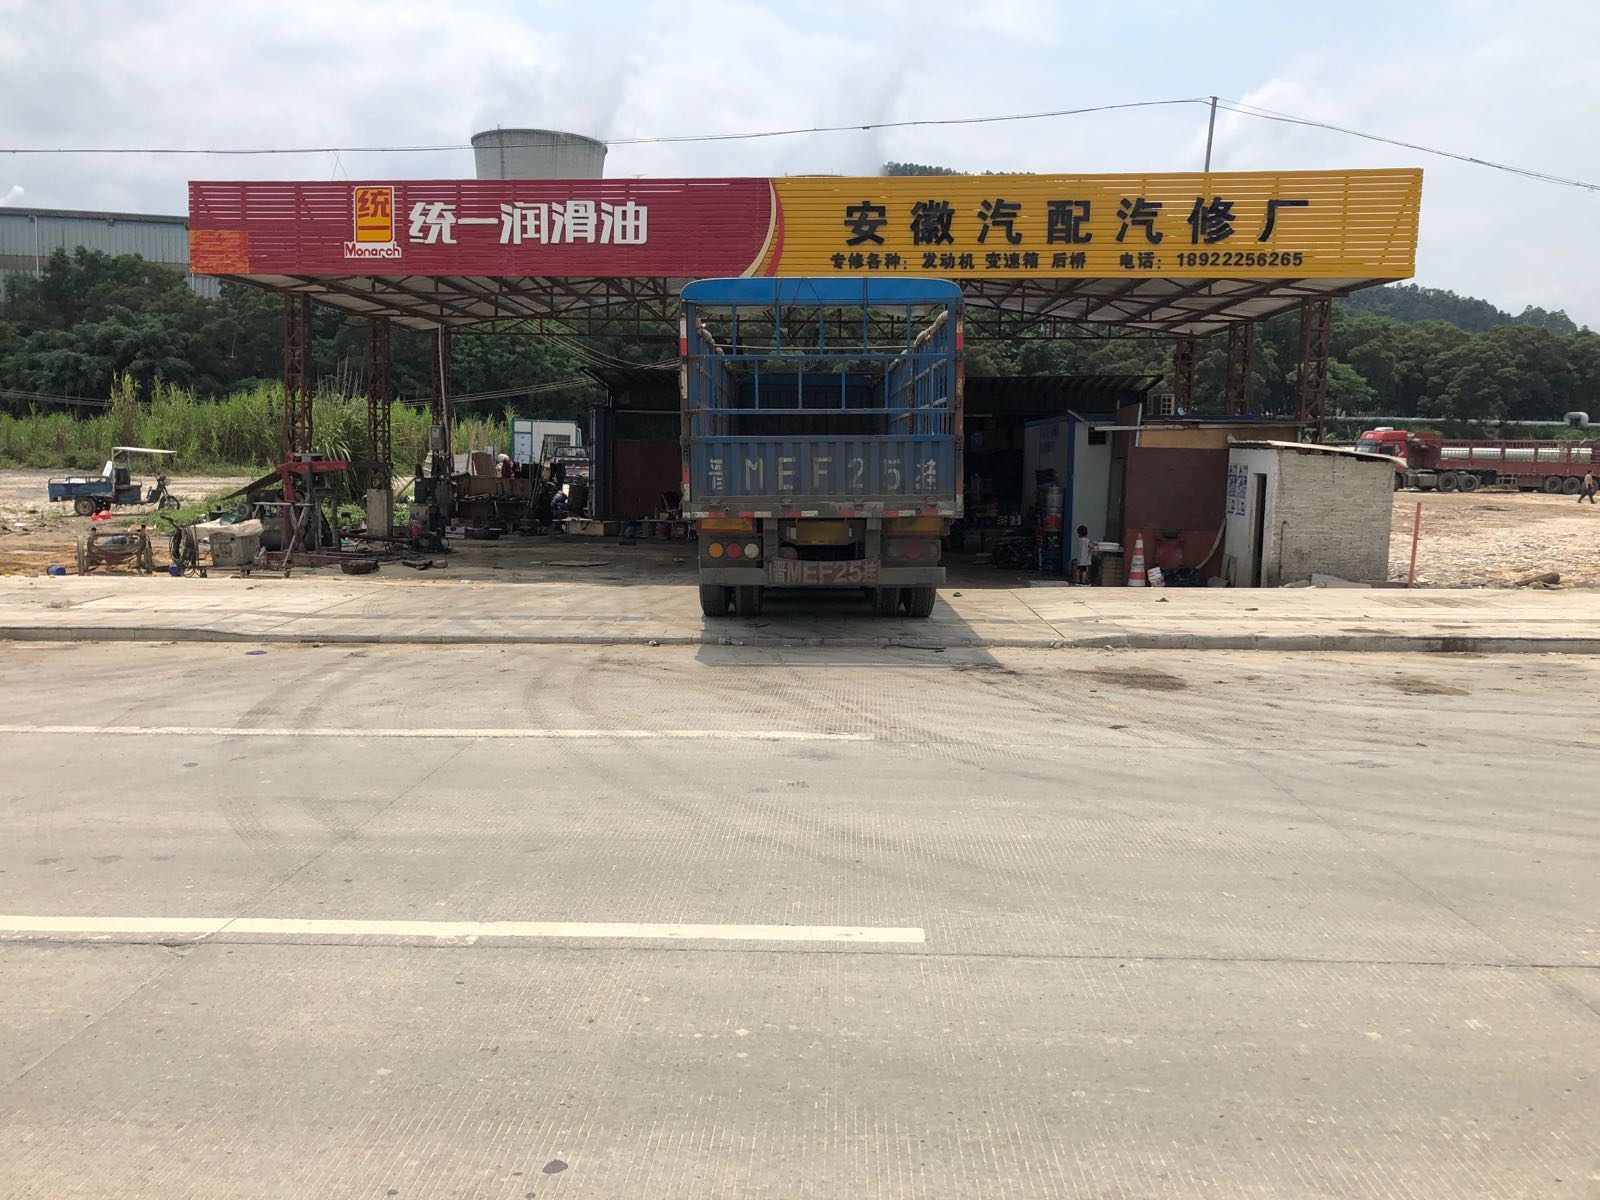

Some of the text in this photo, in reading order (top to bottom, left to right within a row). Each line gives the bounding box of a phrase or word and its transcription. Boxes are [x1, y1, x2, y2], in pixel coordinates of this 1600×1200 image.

[408, 200, 648, 245] 统一润滑油
[843, 197, 1309, 246] 安徽汽配汽修厂
[345, 243, 400, 257] Monarch
[922, 252, 975, 270] 发动机
[985, 252, 1039, 269] 变速箱
[1051, 252, 1087, 269] 后桥
[1176, 252, 1303, 268] 18922256265
